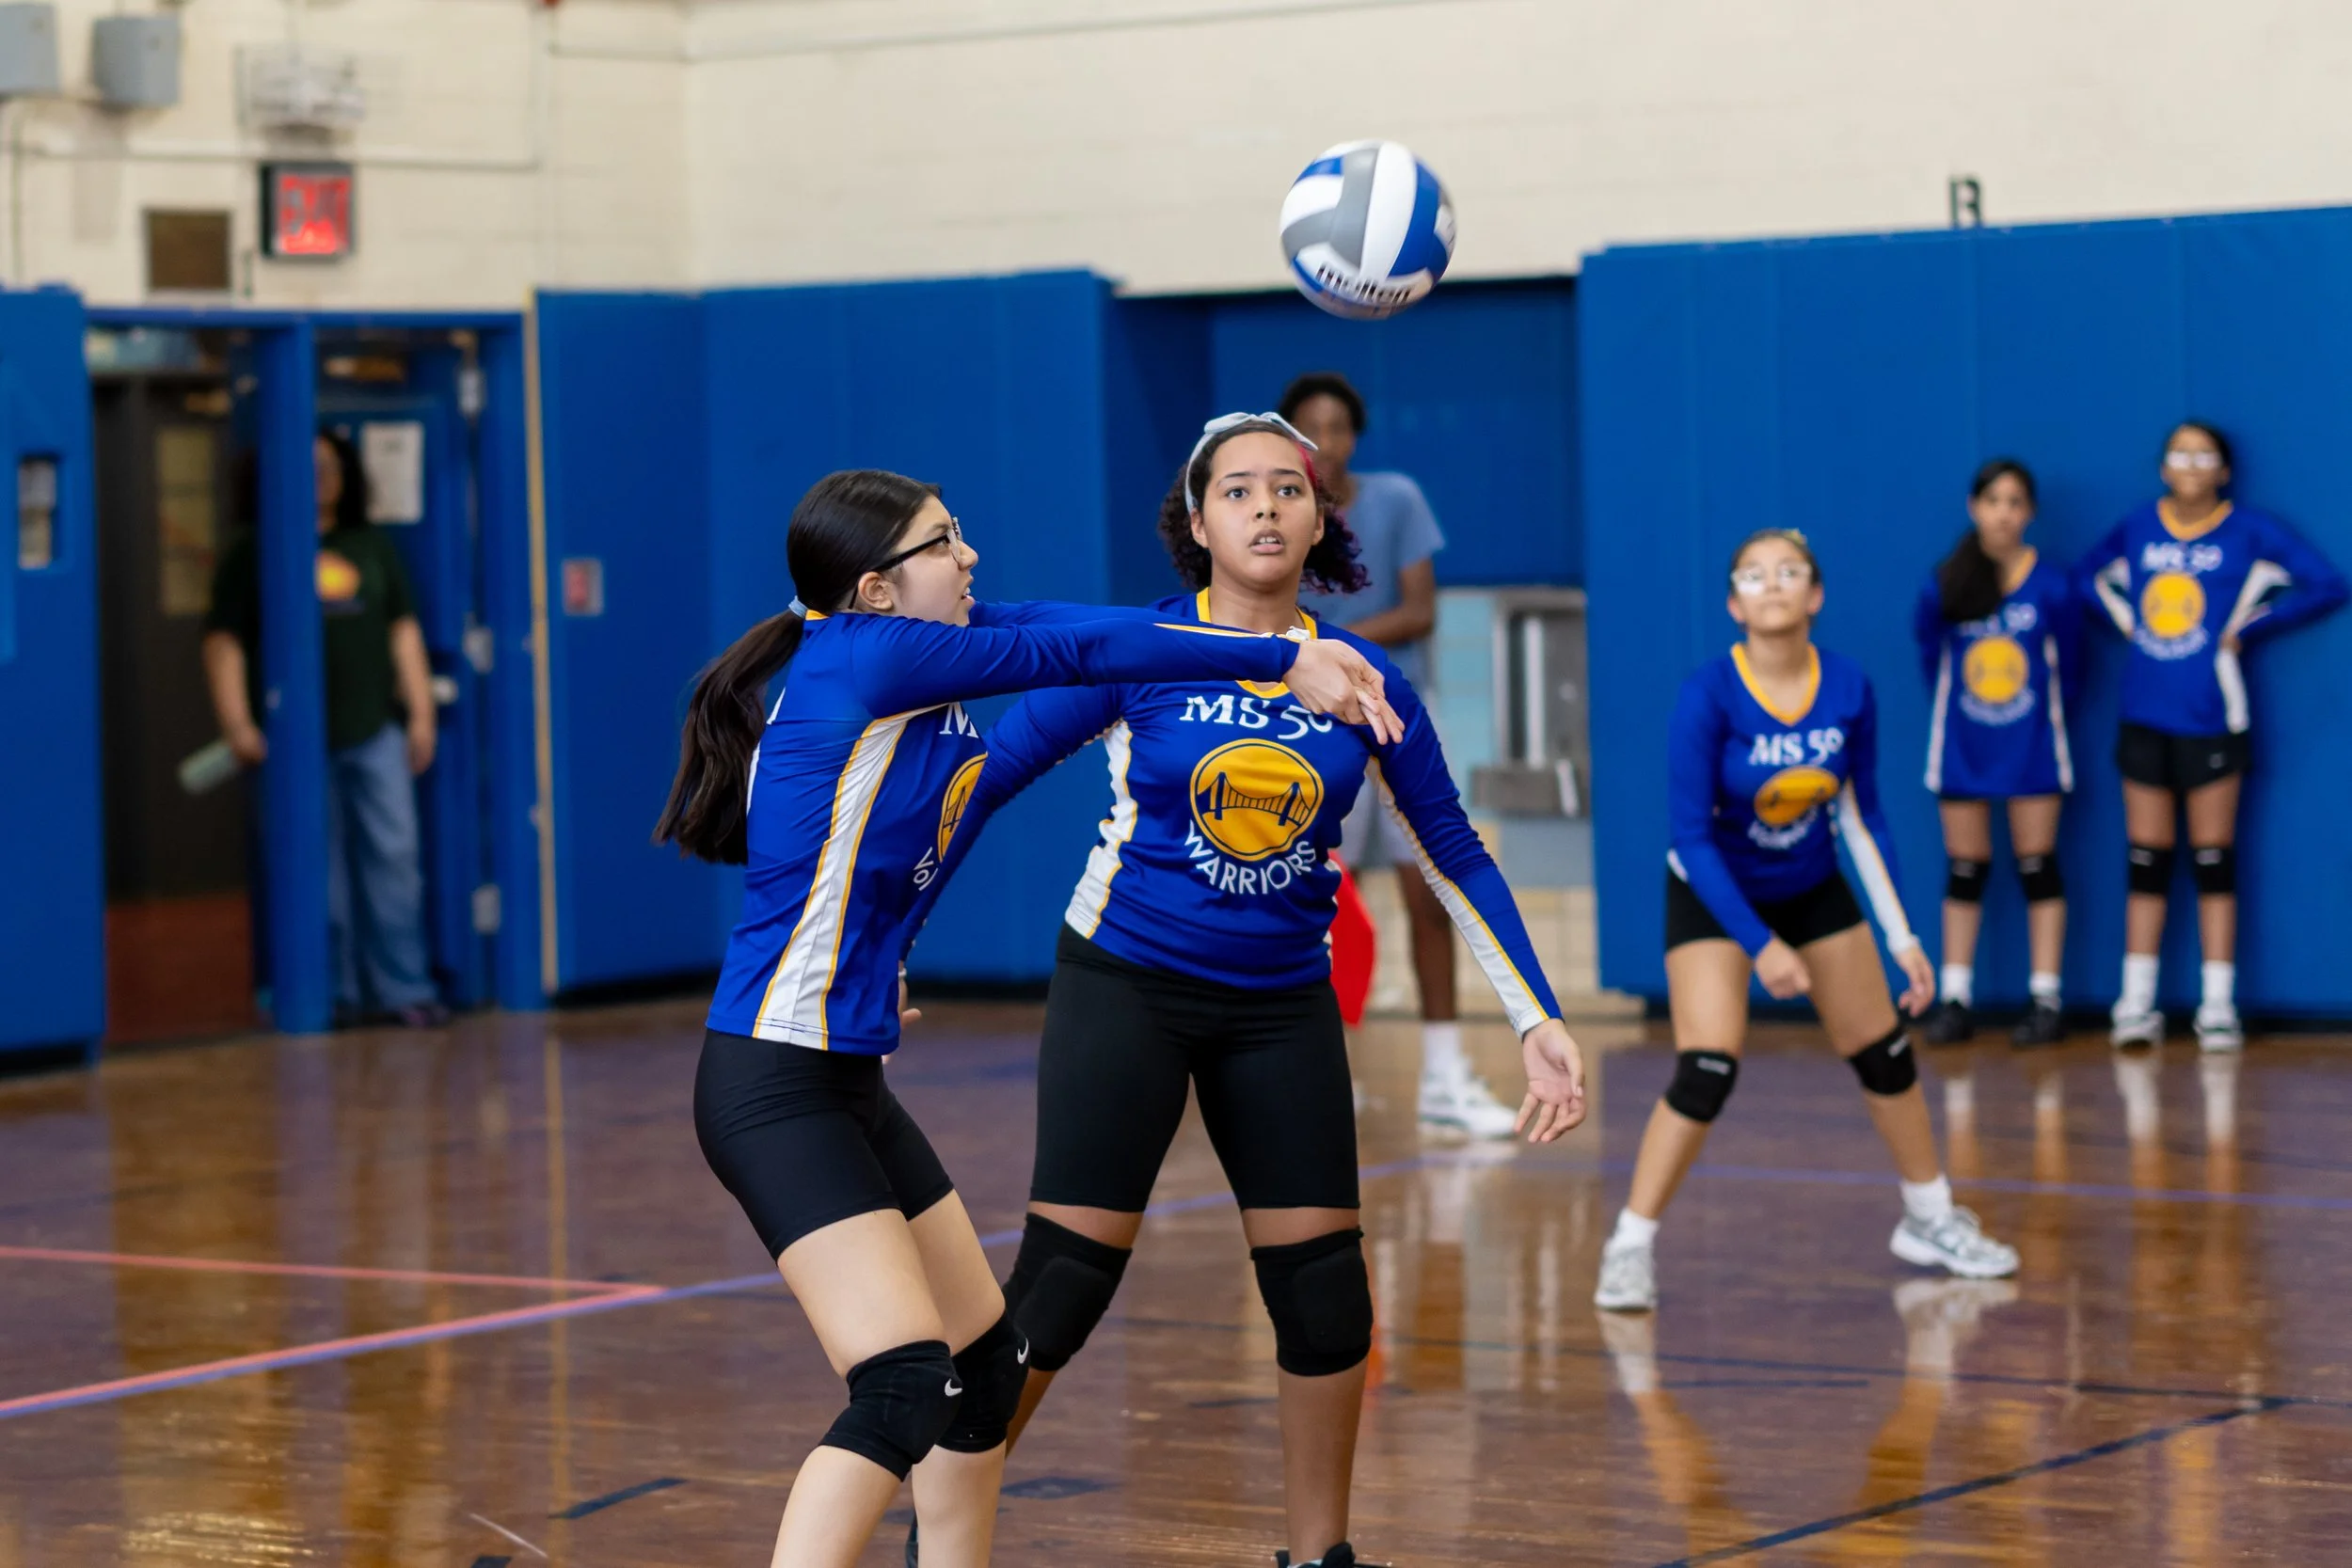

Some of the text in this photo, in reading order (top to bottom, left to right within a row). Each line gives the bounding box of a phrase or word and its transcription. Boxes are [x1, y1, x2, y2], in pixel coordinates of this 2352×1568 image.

[1179, 694, 1270, 729] MS
[1748, 727, 1845, 767] MS 50
[1184, 819, 1317, 895] WARRIORS
